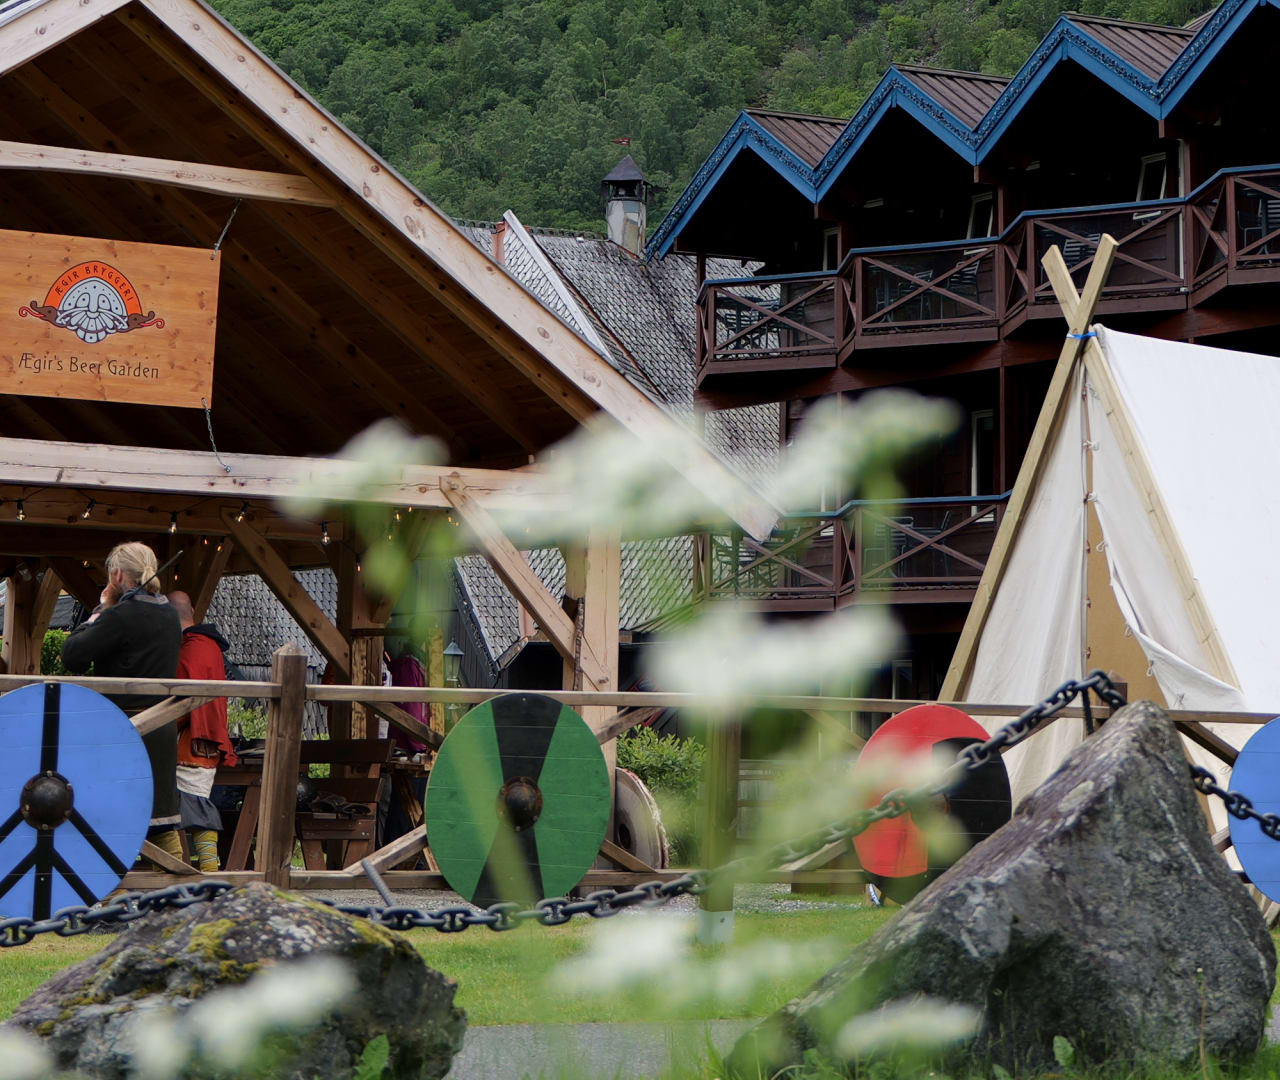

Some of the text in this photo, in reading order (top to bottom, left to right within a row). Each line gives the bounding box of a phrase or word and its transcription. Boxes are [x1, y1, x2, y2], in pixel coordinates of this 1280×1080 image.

[55, 265, 134, 301] ÆGIR BRYGGERI
[19, 352, 159, 378] Ægir's Beer Garden
